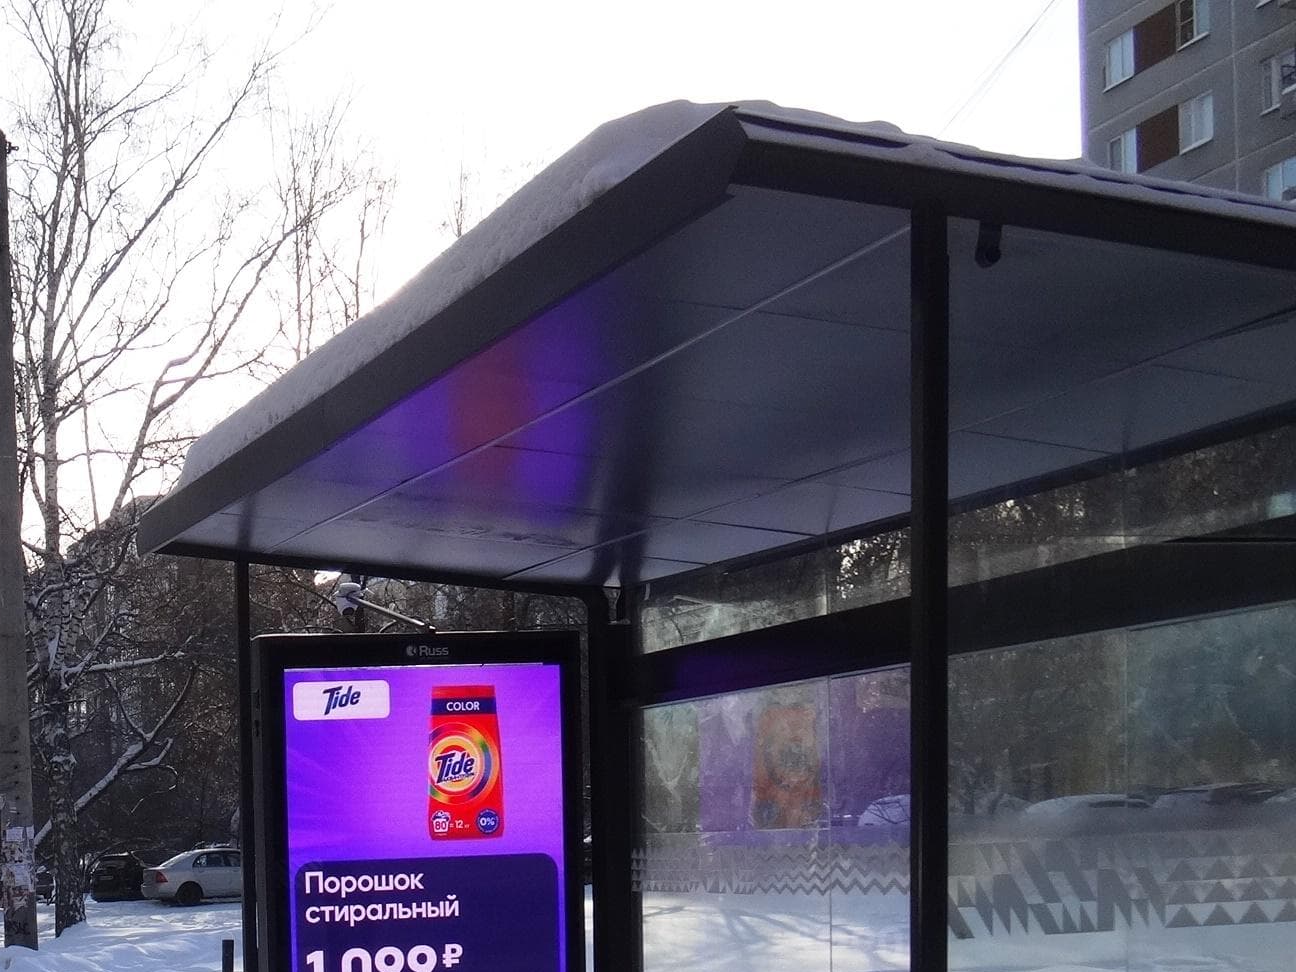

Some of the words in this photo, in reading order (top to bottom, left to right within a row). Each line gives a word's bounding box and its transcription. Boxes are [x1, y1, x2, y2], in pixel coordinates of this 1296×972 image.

[419, 645, 449, 657] Russ
[323, 686, 360, 715] Tide
[446, 700, 480, 712] COLOR
[435, 752, 475, 784] Tide
[435, 820, 447, 830] 80
[479, 817, 495, 826] 0%
[305, 871, 424, 898] Порошок
[305, 894, 460, 927] стиральный
